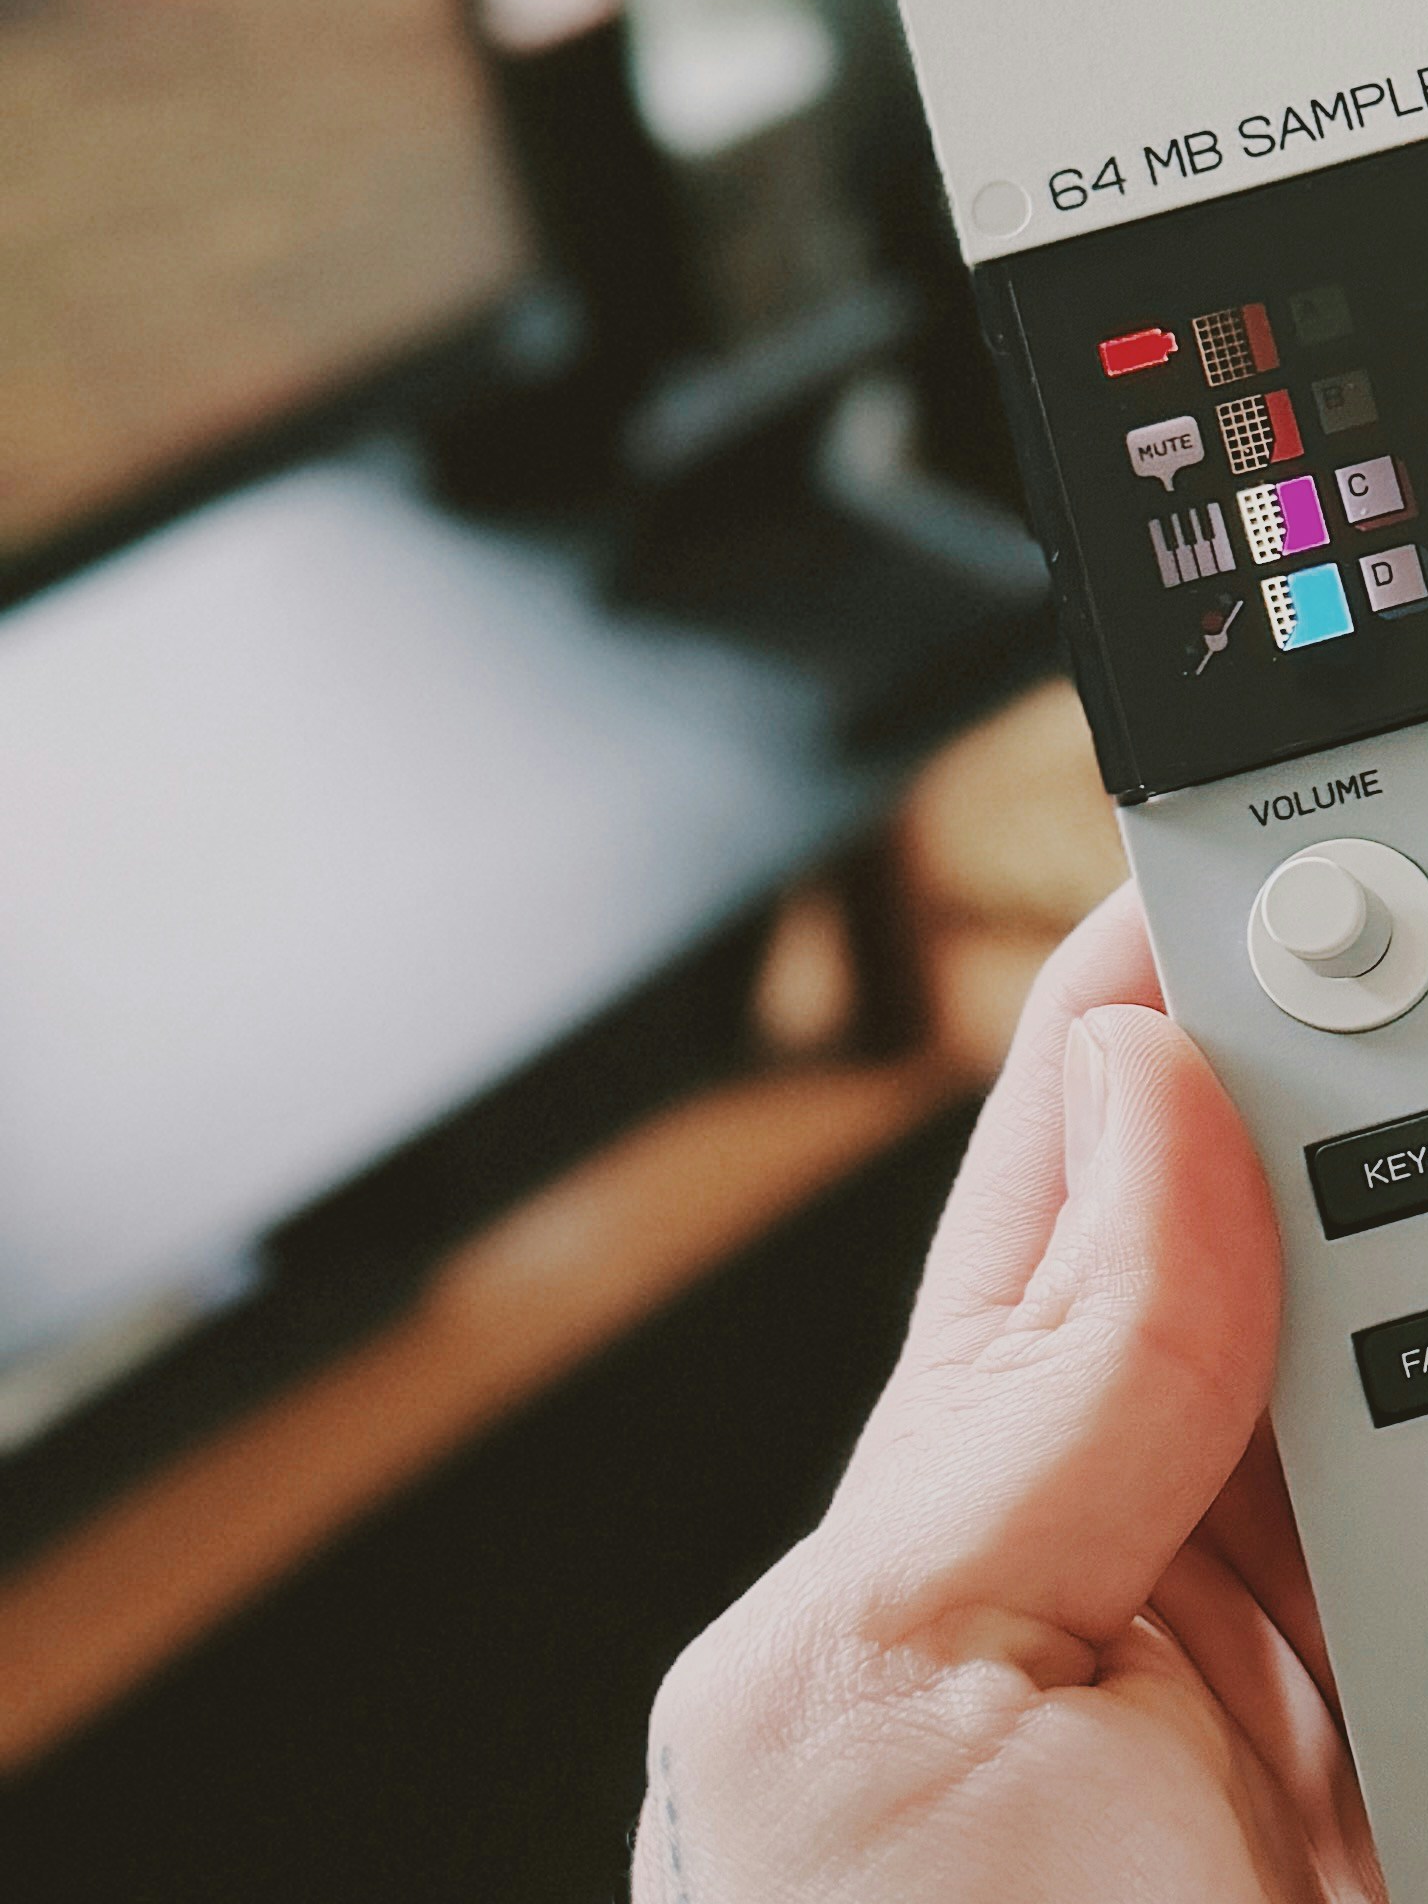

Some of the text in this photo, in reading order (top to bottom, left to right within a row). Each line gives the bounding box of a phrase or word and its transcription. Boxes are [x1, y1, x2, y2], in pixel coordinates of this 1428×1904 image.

[1049, 155, 1129, 213] 64
[1142, 130, 1224, 190] MB
[1137, 433, 1194, 463] MUTE
[1348, 473, 1371, 499] C
[1372, 562, 1394, 588] D
[1249, 768, 1384, 829] VOLUME
